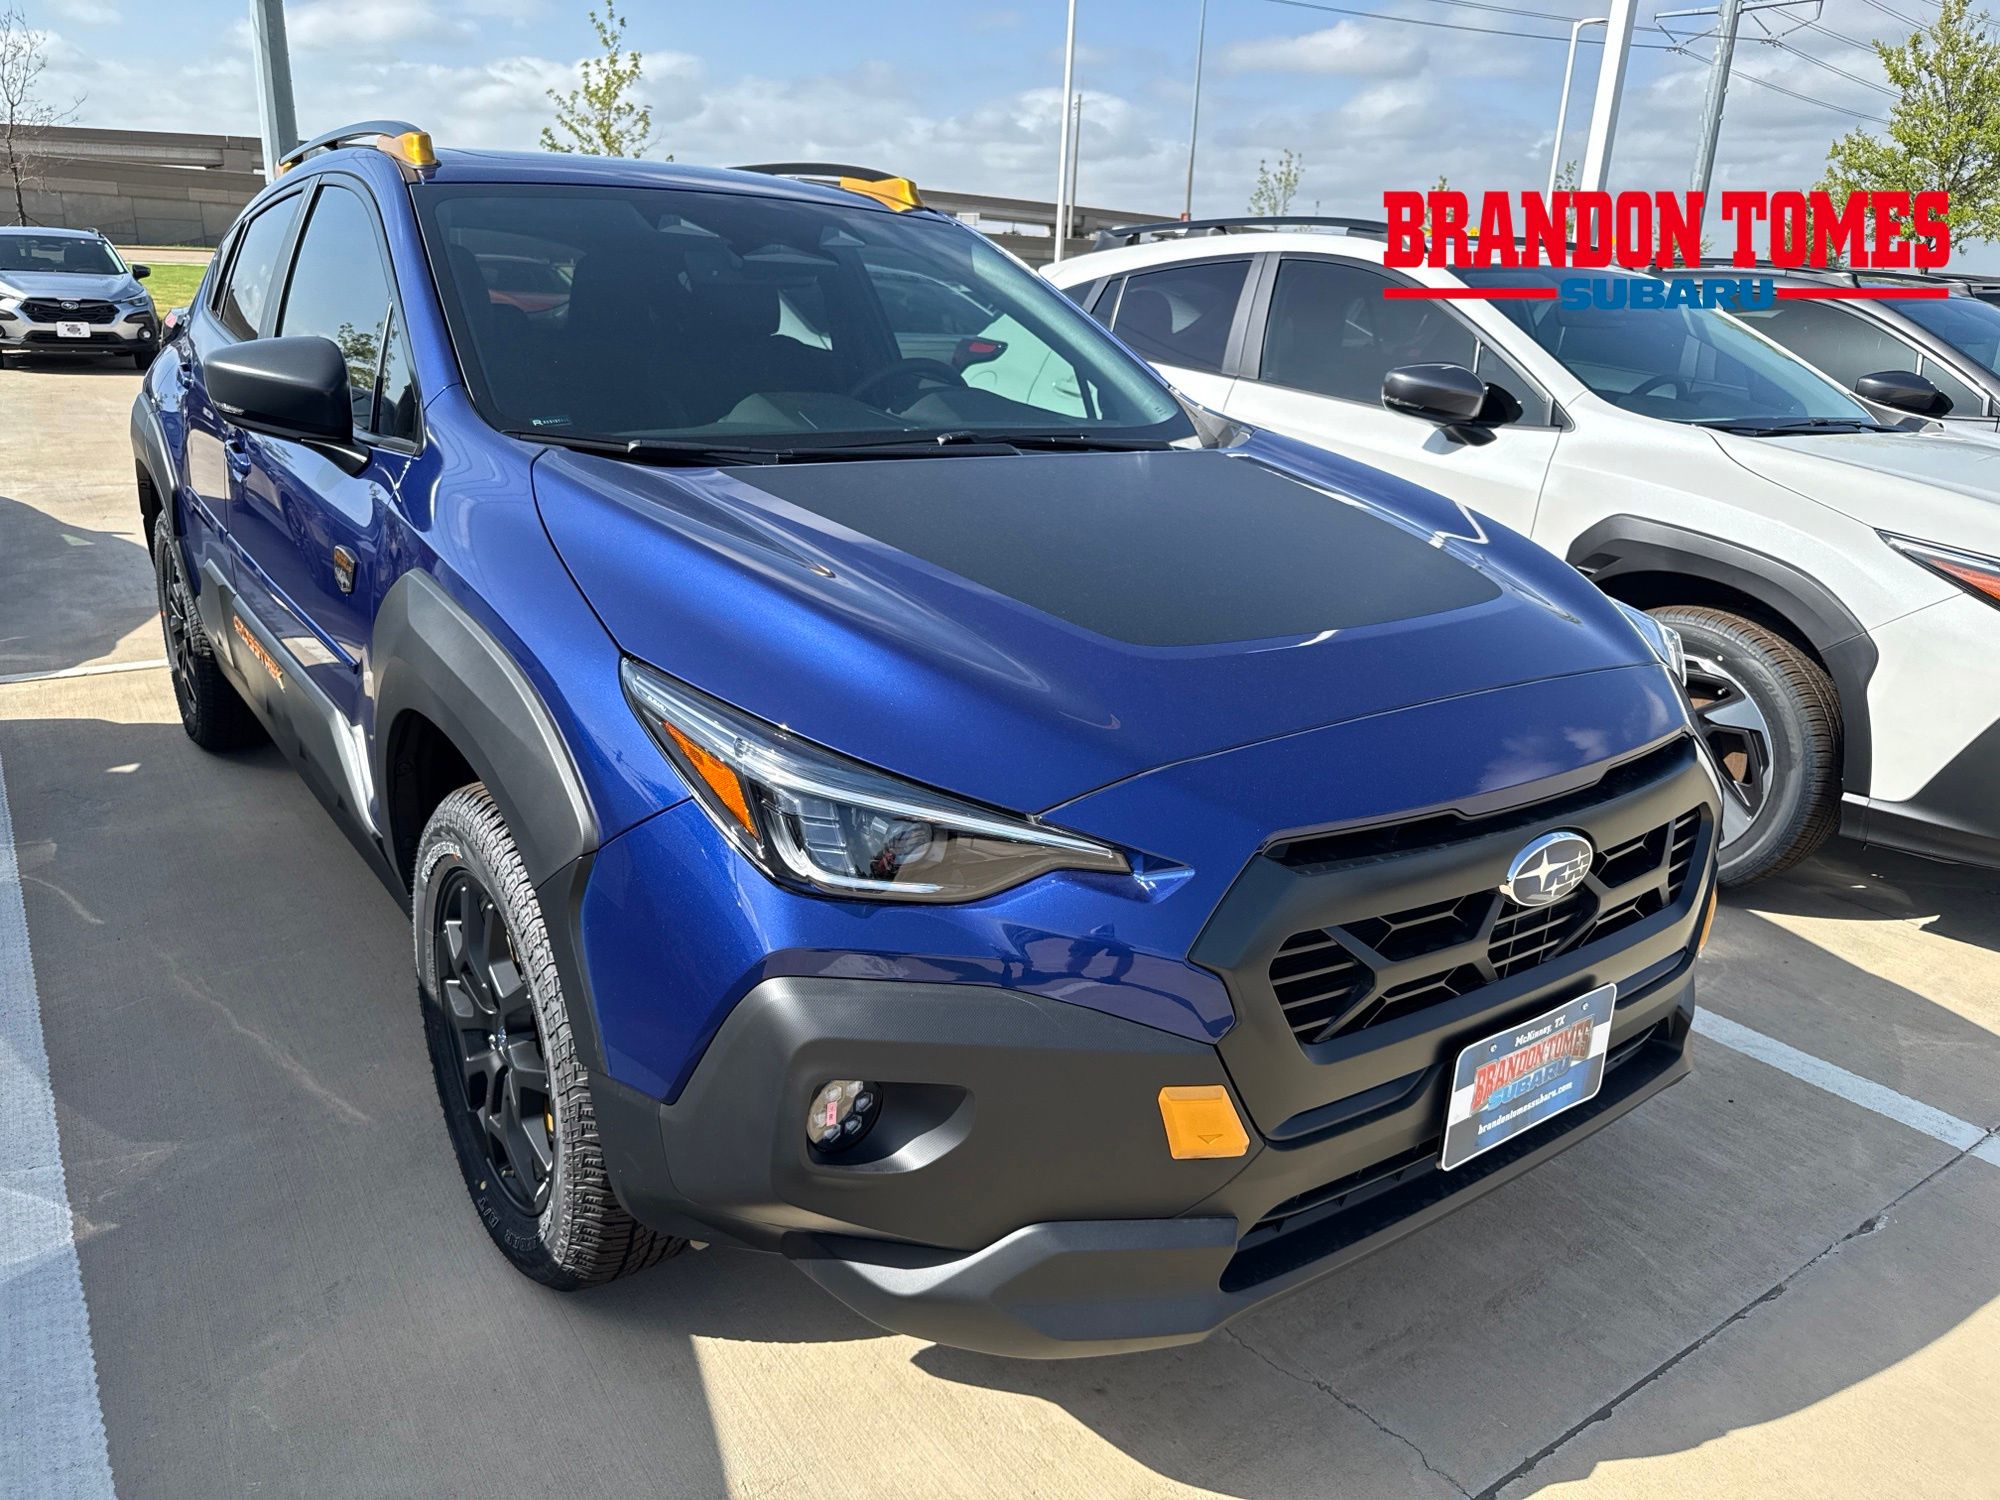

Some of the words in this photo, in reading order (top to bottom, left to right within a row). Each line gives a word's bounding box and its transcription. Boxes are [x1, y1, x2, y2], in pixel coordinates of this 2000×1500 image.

[1555, 1015, 1566, 1028] TX
[1471, 1038, 1548, 1113] BRANDON
[1547, 1016, 1594, 1060] TOMES
[1488, 1054, 1572, 1111] SUBARU
